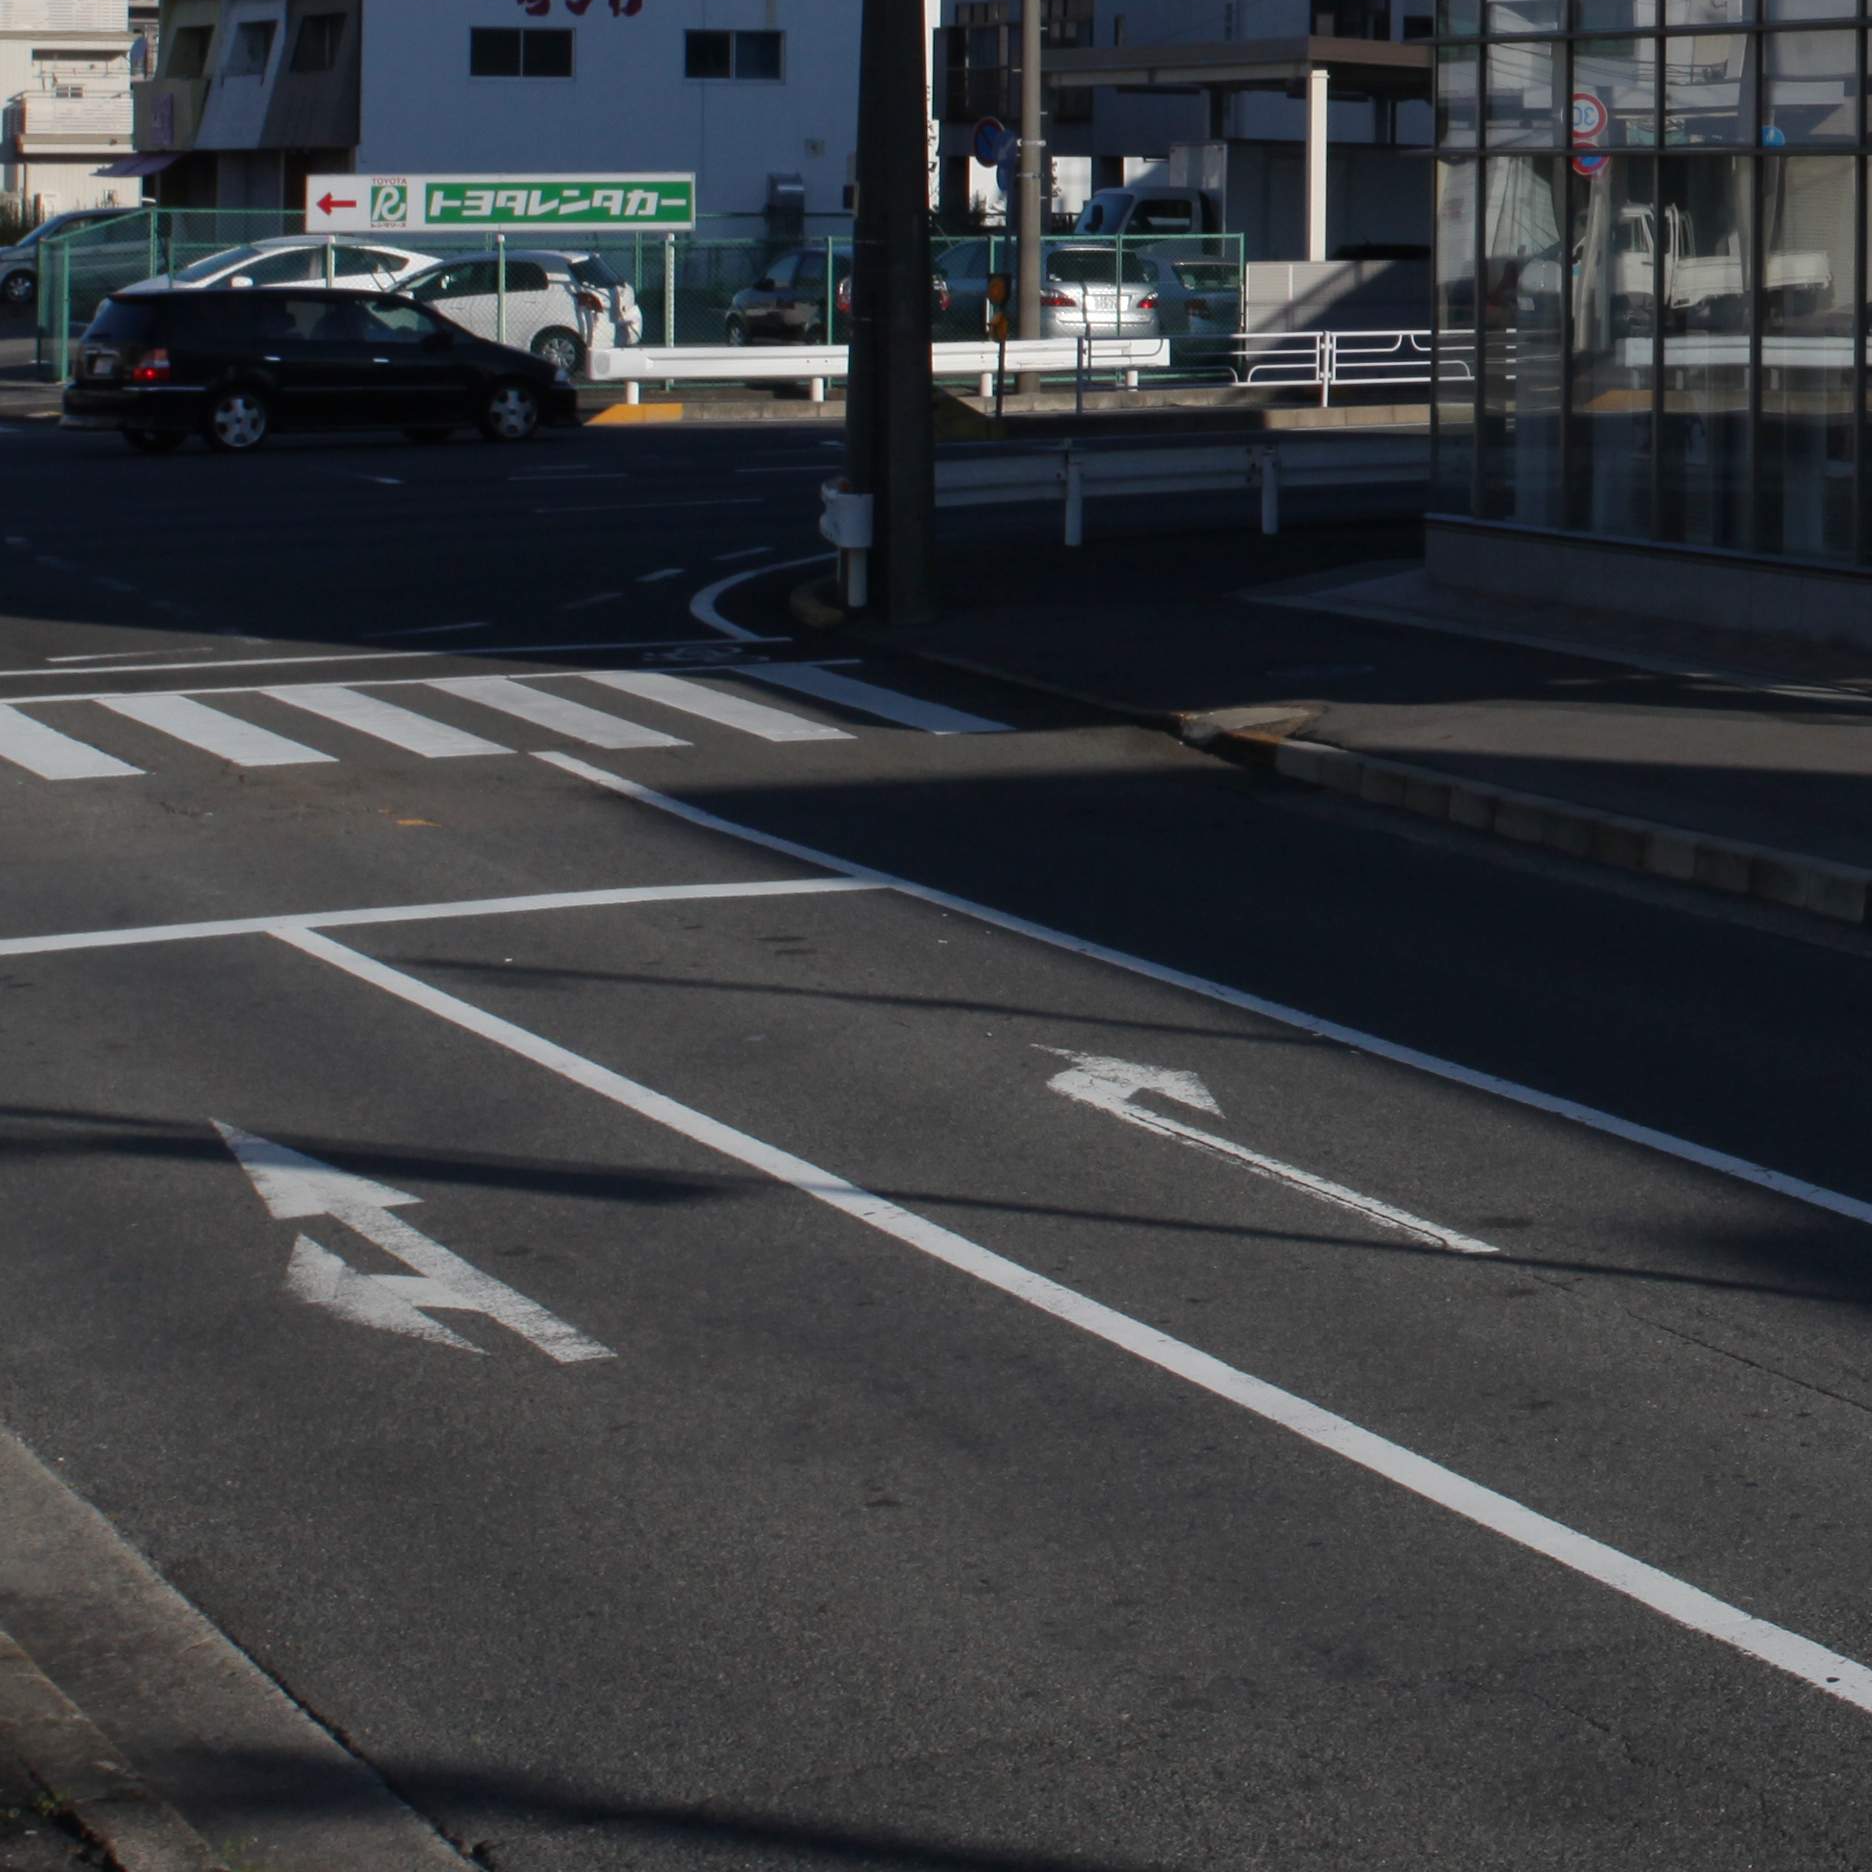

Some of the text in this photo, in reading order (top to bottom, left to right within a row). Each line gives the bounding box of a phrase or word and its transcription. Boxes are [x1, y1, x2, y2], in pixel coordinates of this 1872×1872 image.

[372, 177, 408, 185] TOYOTA
[429, 189, 688, 217] トヨタレンタカー
